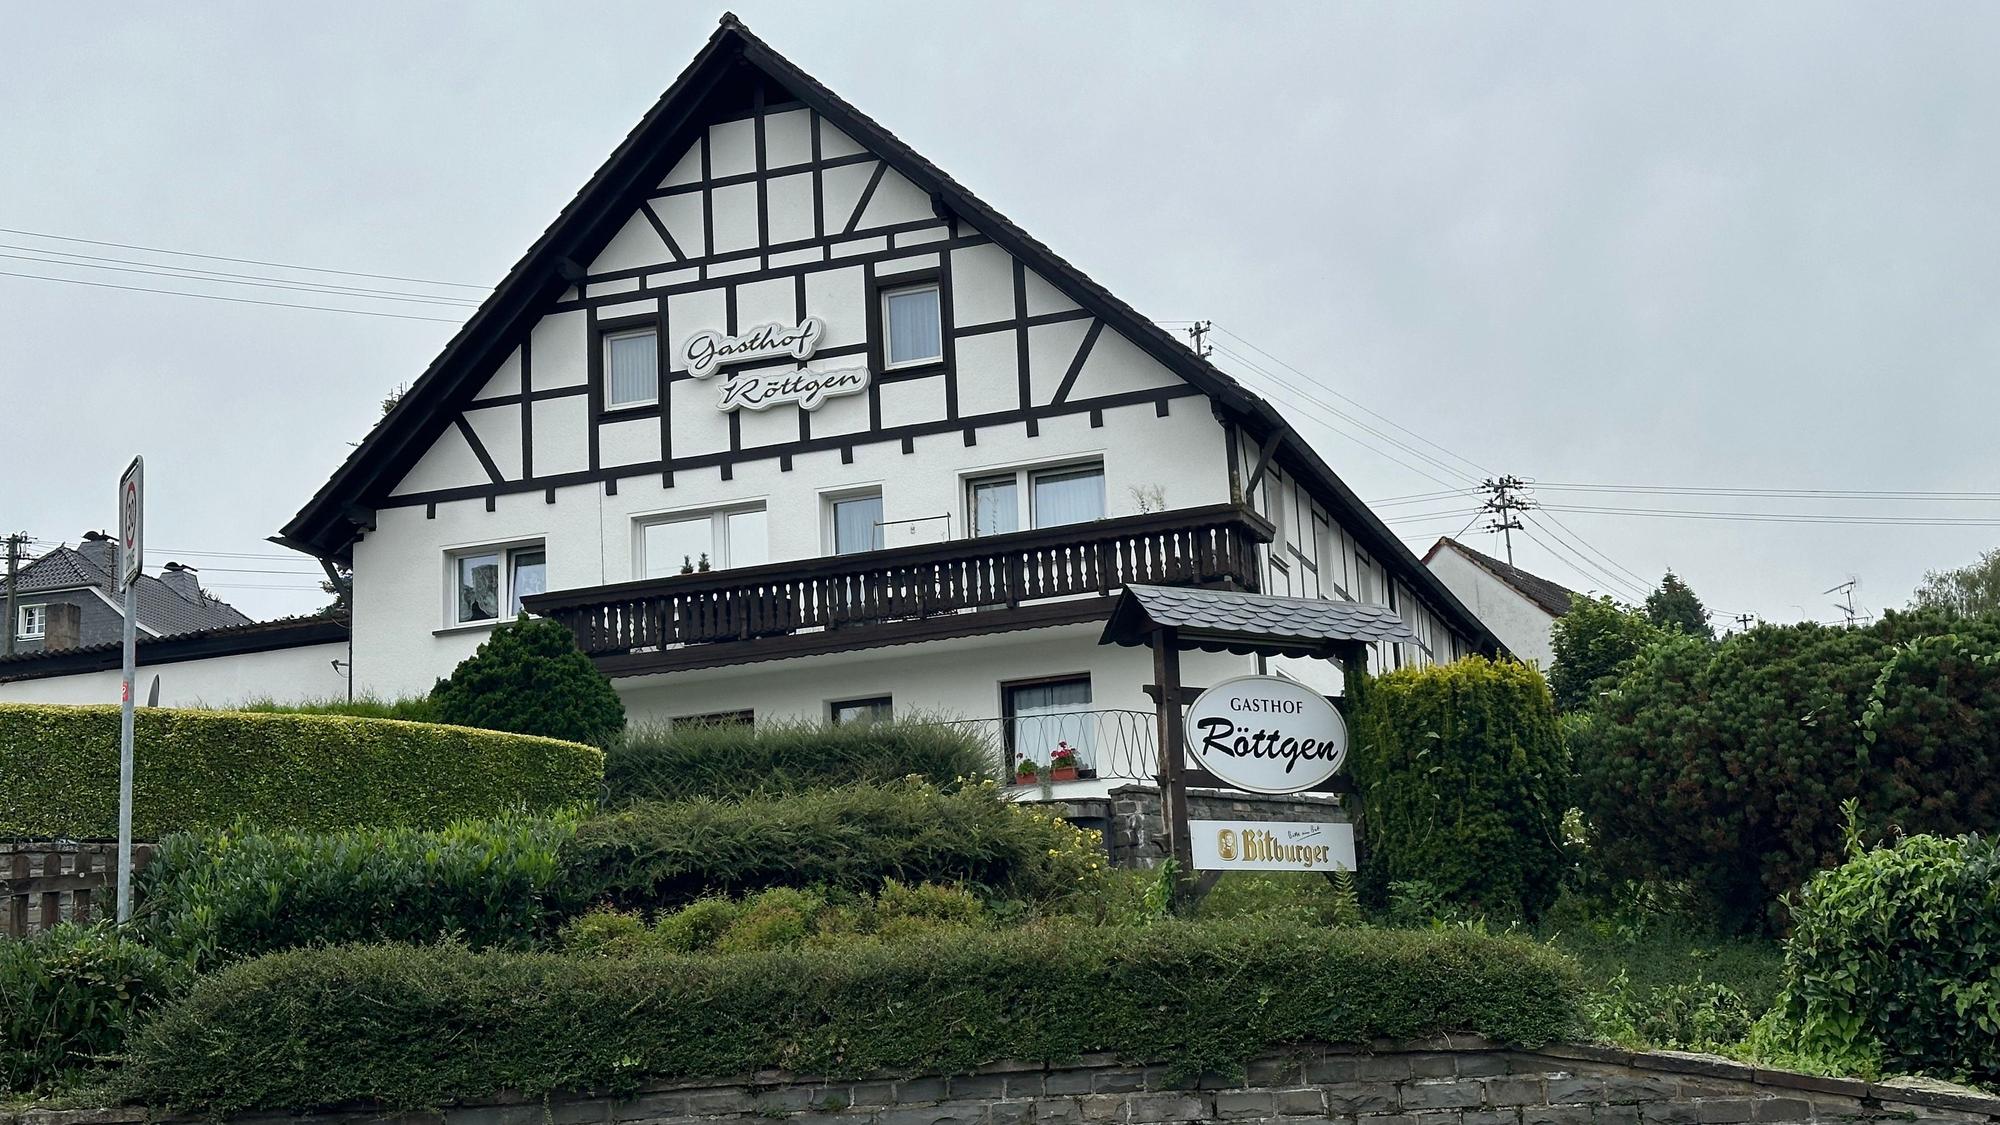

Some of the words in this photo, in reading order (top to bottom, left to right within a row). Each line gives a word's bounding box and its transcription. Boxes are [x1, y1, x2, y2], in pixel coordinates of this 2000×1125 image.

[687, 320, 814, 370] Gasthof
[723, 375, 861, 404] Röttgen
[1230, 697, 1303, 714] GASTHOF
[1197, 717, 1338, 774] Röttgen
[1241, 829, 1329, 867] Bitburger
